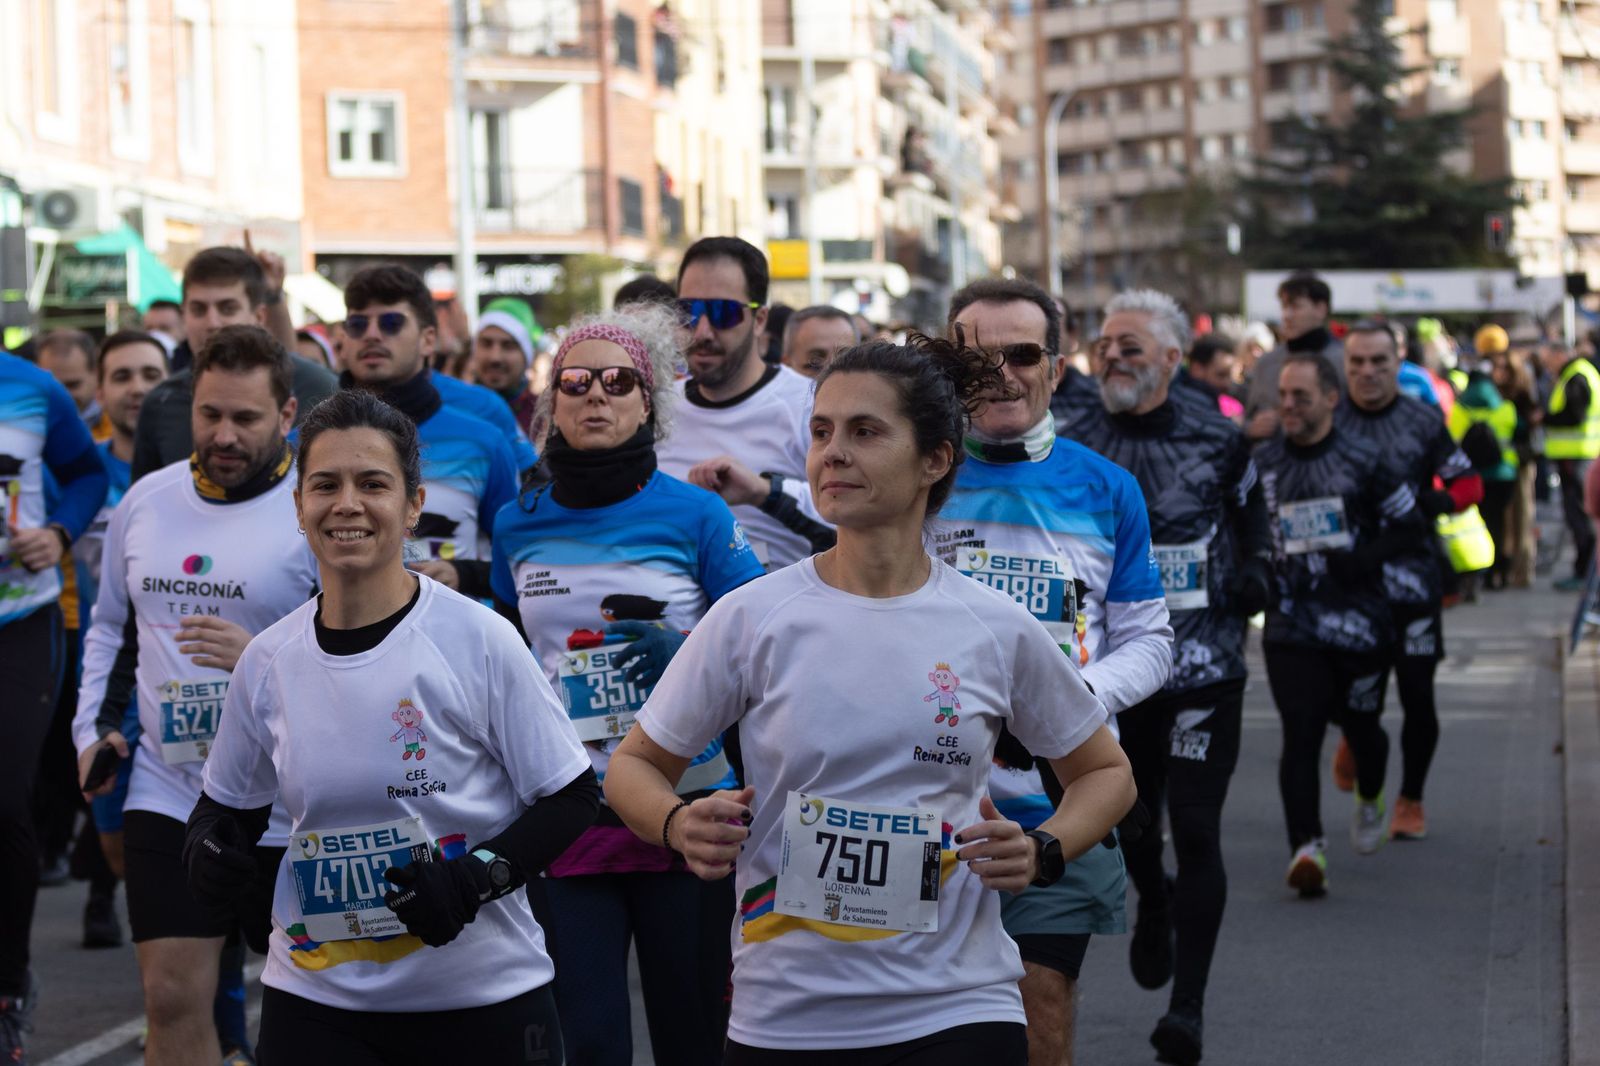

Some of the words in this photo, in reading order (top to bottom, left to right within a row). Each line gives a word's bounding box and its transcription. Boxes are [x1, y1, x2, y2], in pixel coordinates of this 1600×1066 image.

[953, 529, 975, 539] SAN
[1159, 549, 1199, 560] ETEL
[991, 555, 1064, 575] SETEL
[142, 577, 245, 600] SINCRONÍA
[523, 587, 571, 598] ALMANTINA
[972, 573, 1050, 614] 88
[167, 602, 220, 617] TEAM
[181, 681, 229, 698] SET
[172, 700, 224, 736] 527
[937, 735, 959, 747] CEE
[913, 746, 945, 764] Reina
[406, 769, 428, 781] CEE
[387, 785, 418, 799] Reina
[826, 807, 929, 835] SETEL
[322, 828, 410, 853] SETEL
[816, 831, 889, 886] 750
[314, 853, 399, 904] 4703
[824, 881, 871, 896] LORENNA
[345, 900, 374, 911] MARTA
[843, 904, 888, 916] Ayuntamiento
[852, 914, 887, 926] Salamanca
